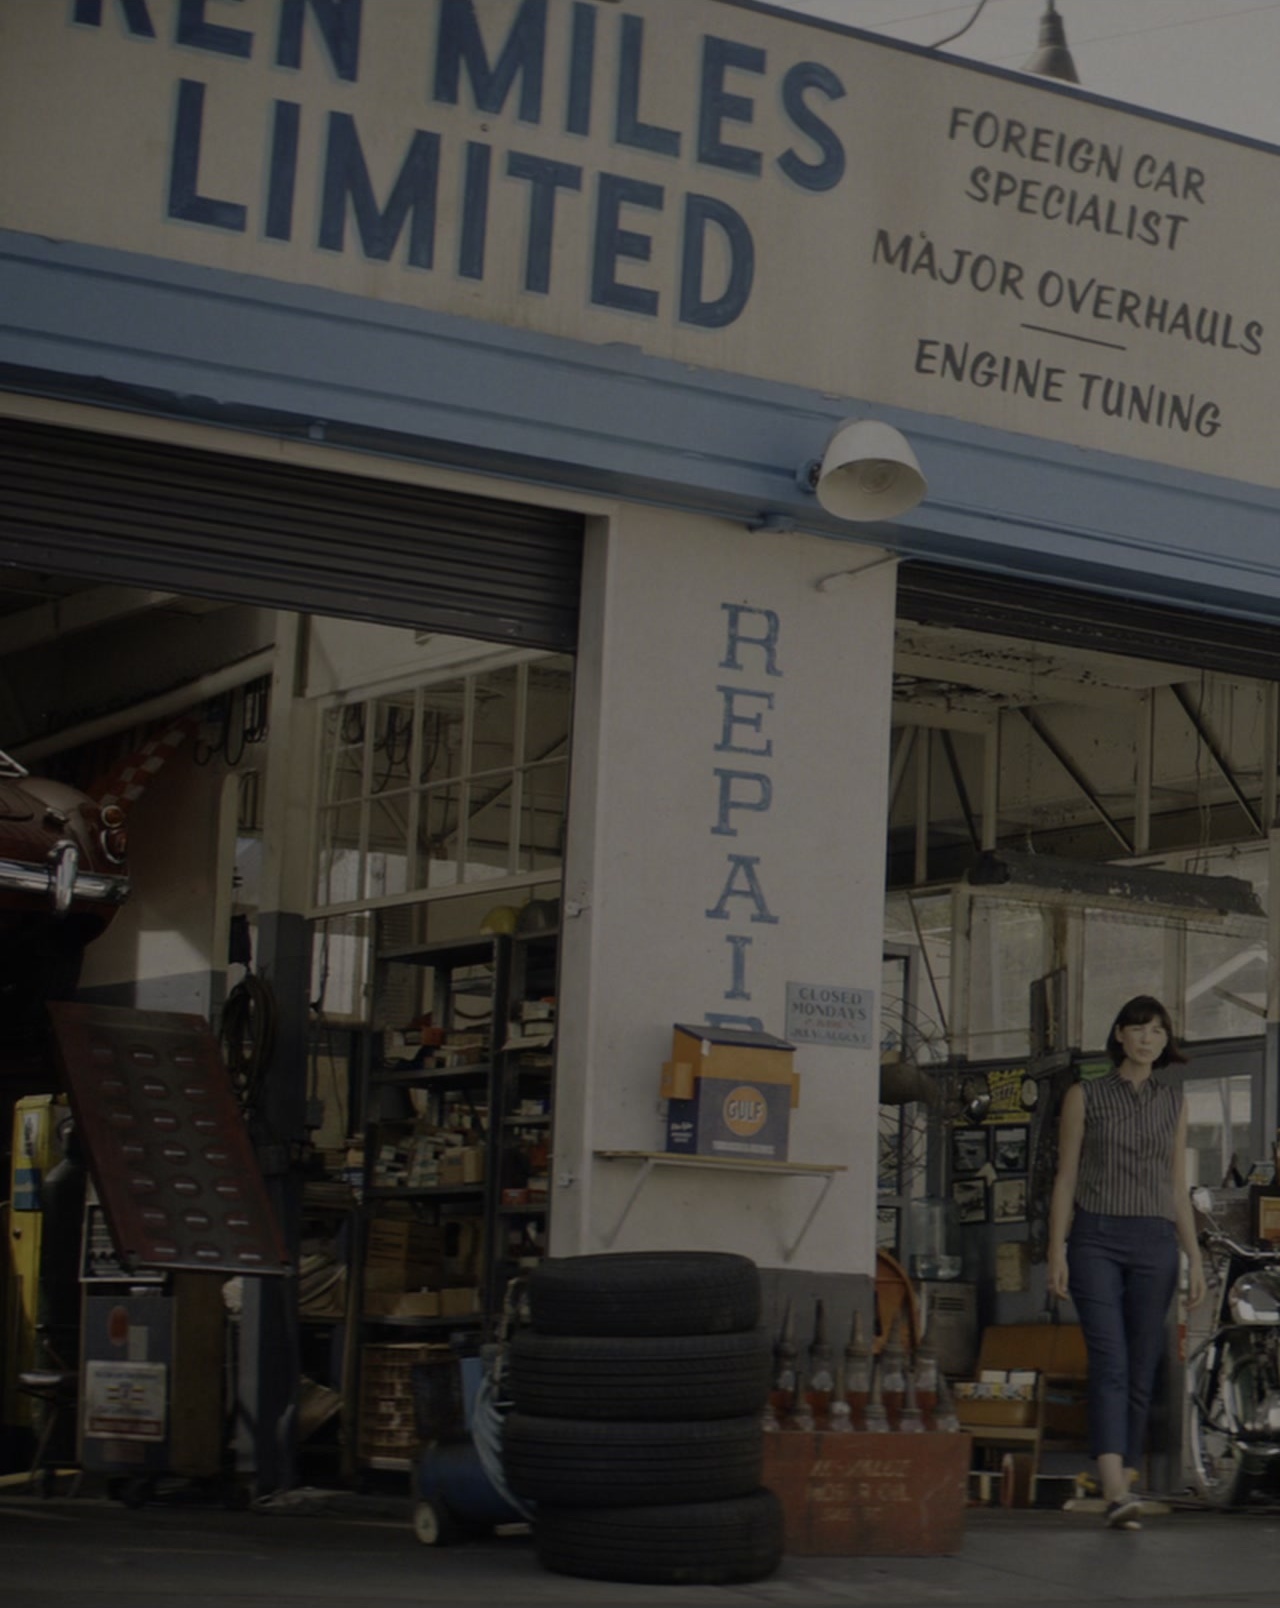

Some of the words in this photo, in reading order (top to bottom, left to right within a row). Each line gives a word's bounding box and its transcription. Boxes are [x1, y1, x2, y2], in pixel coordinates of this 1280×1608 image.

[432, 0, 847, 192] MILES
[166, 77, 757, 329] LIMITED
[948, 106, 1124, 184] FOREIGN
[1133, 154, 1206, 205] CAR
[964, 165, 1189, 251] SPECIALIST
[871, 228, 1025, 301] MAJOR
[1037, 270, 1264, 356] OVERHAULS
[914, 338, 1066, 403] ENGINE
[1077, 372, 1223, 438] TUNING
[705, 603, 783, 1032] REPAI
[793, 1002, 866, 1020] MONDAYS
[799, 988, 862, 1004] CLOSED
[726, 1099, 766, 1123] GULF
